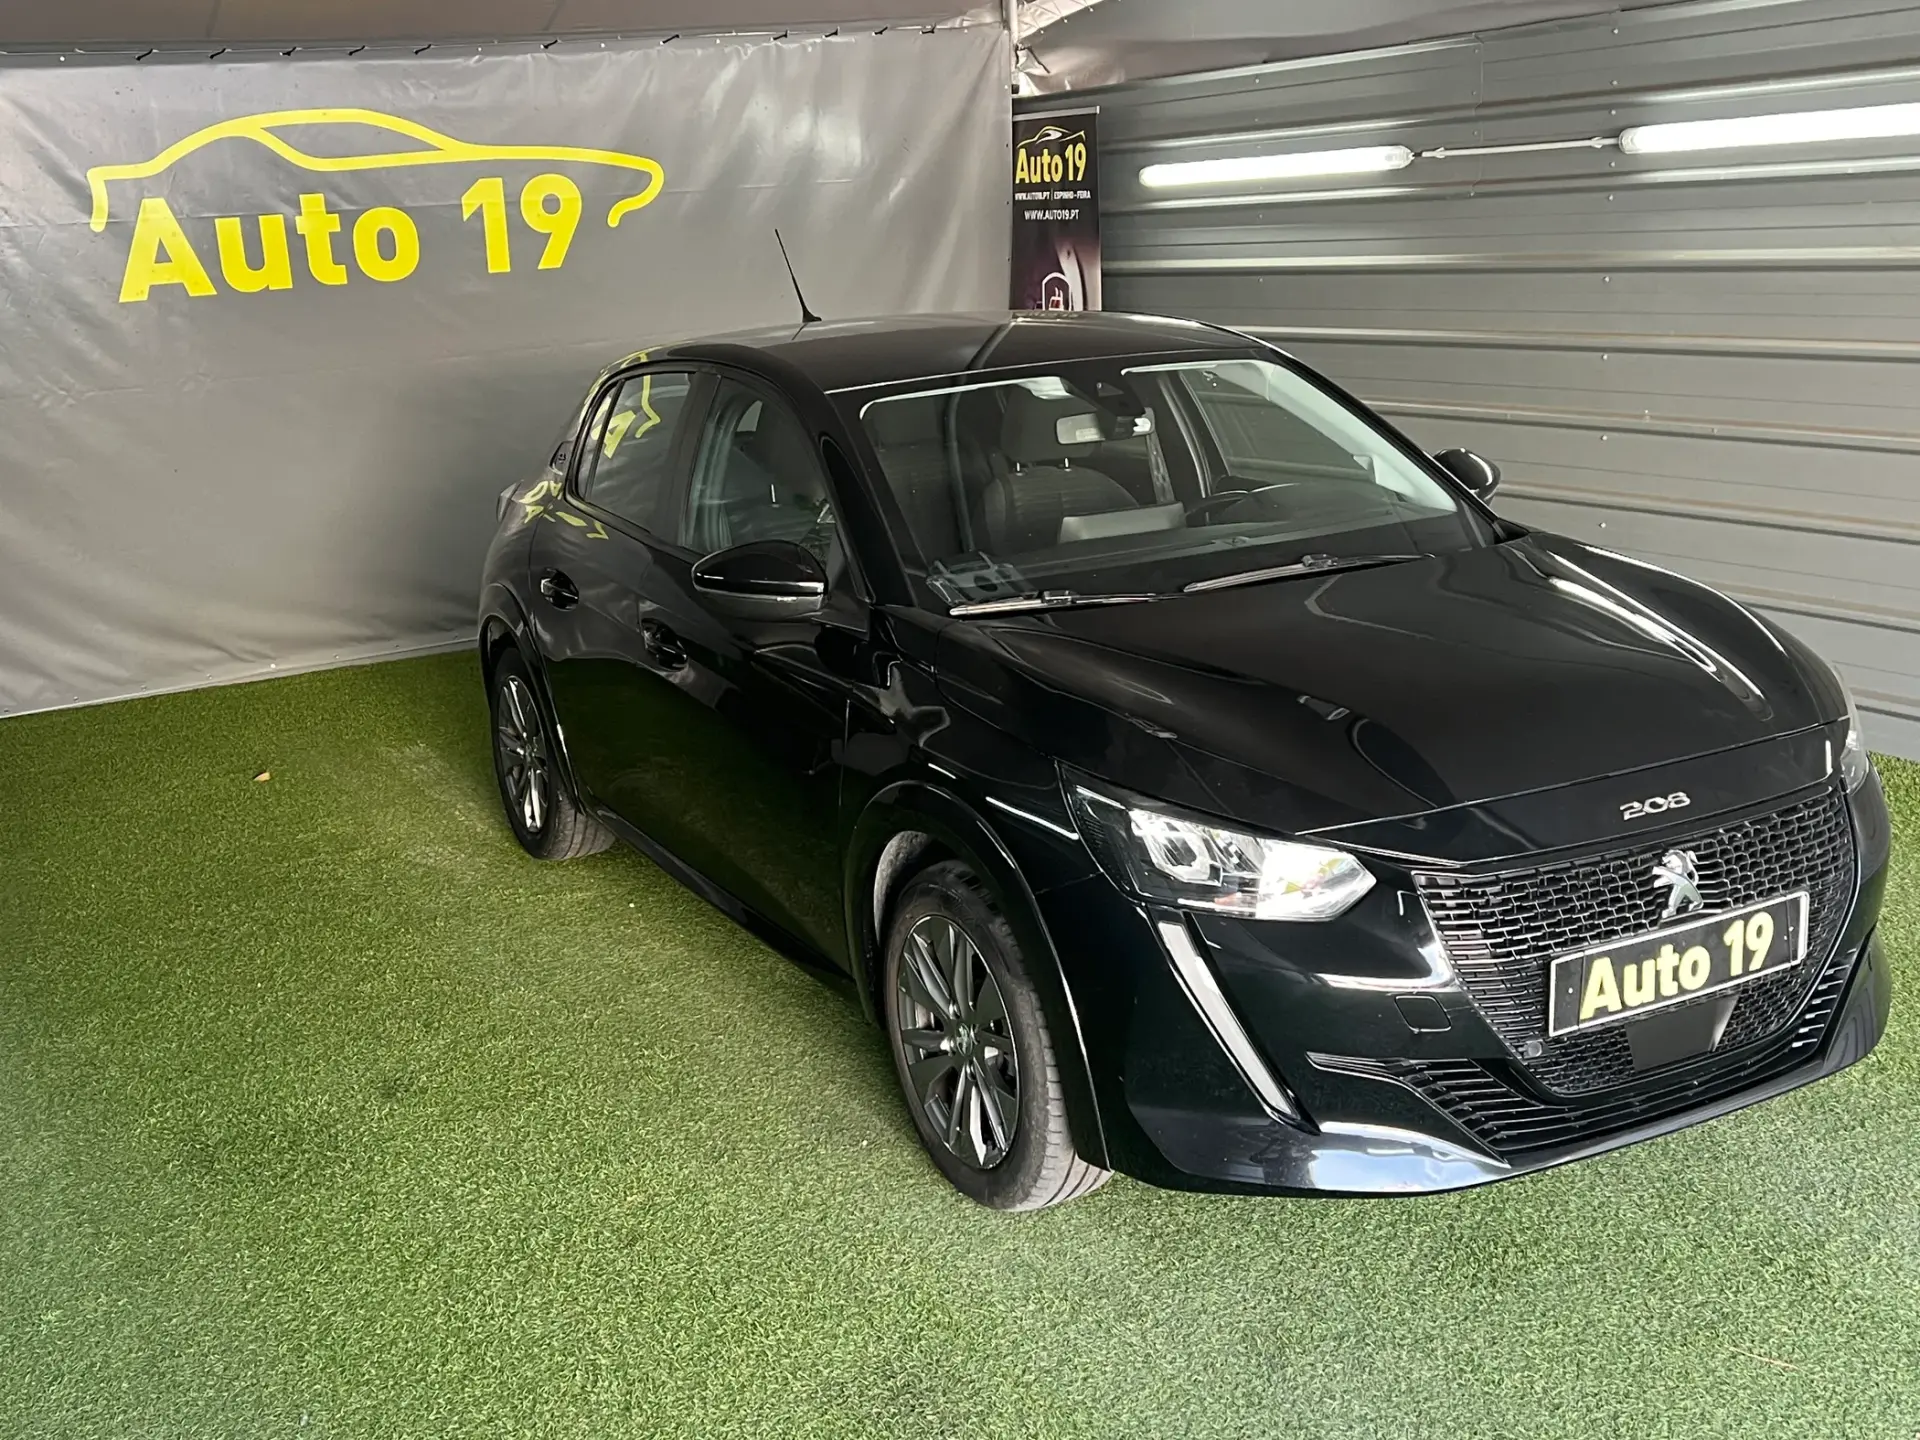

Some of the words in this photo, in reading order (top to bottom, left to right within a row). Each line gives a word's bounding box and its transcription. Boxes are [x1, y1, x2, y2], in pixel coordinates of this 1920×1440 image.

[1015, 148, 1063, 184] Auto
[1065, 142, 1087, 182] 19
[1024, 209, 1079, 220] WWW.AUTO19.PT
[119, 193, 420, 303] Auto
[461, 174, 582, 273] 19
[1620, 791, 1691, 821] 208
[1579, 944, 1711, 1020] Auto
[1723, 911, 1774, 977] 19
